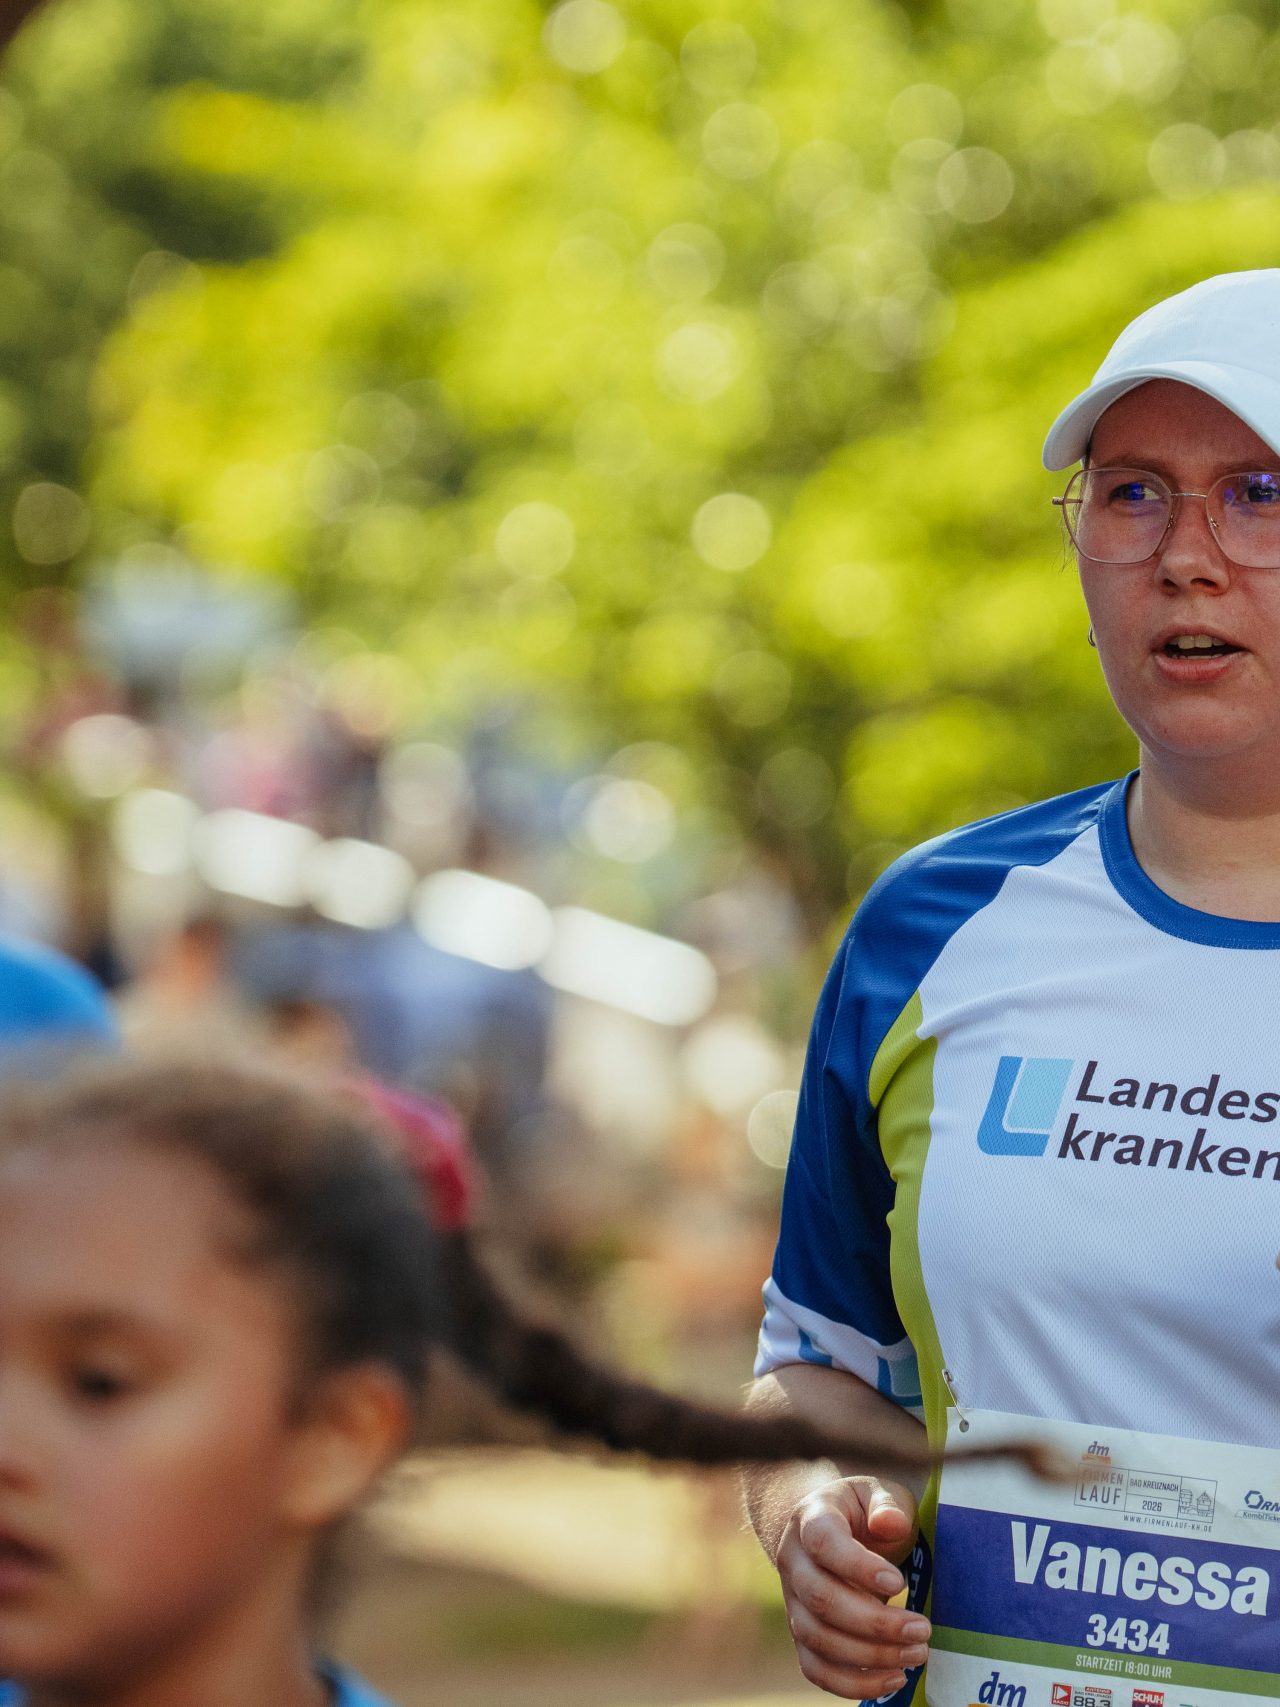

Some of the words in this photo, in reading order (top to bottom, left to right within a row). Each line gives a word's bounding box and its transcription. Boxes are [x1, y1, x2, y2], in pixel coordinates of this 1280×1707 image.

[1087, 1441, 1110, 1456] dm
[1080, 1483, 1122, 1505] LAUF
[1130, 1479, 1142, 1488] BAD
[1143, 1480, 1179, 1492] KREUZNACH
[1142, 1500, 1162, 1512] 2026
[1011, 1521, 1271, 1617] Vanessa
[1085, 1613, 1170, 1656] 3434
[1076, 1654, 1124, 1673] STARTZEIT
[1125, 1661, 1150, 1676] 18:00
[1152, 1665, 1173, 1679] UHR
[978, 1671, 1027, 1707] dm
[1133, 1692, 1164, 1704] SCHUH
